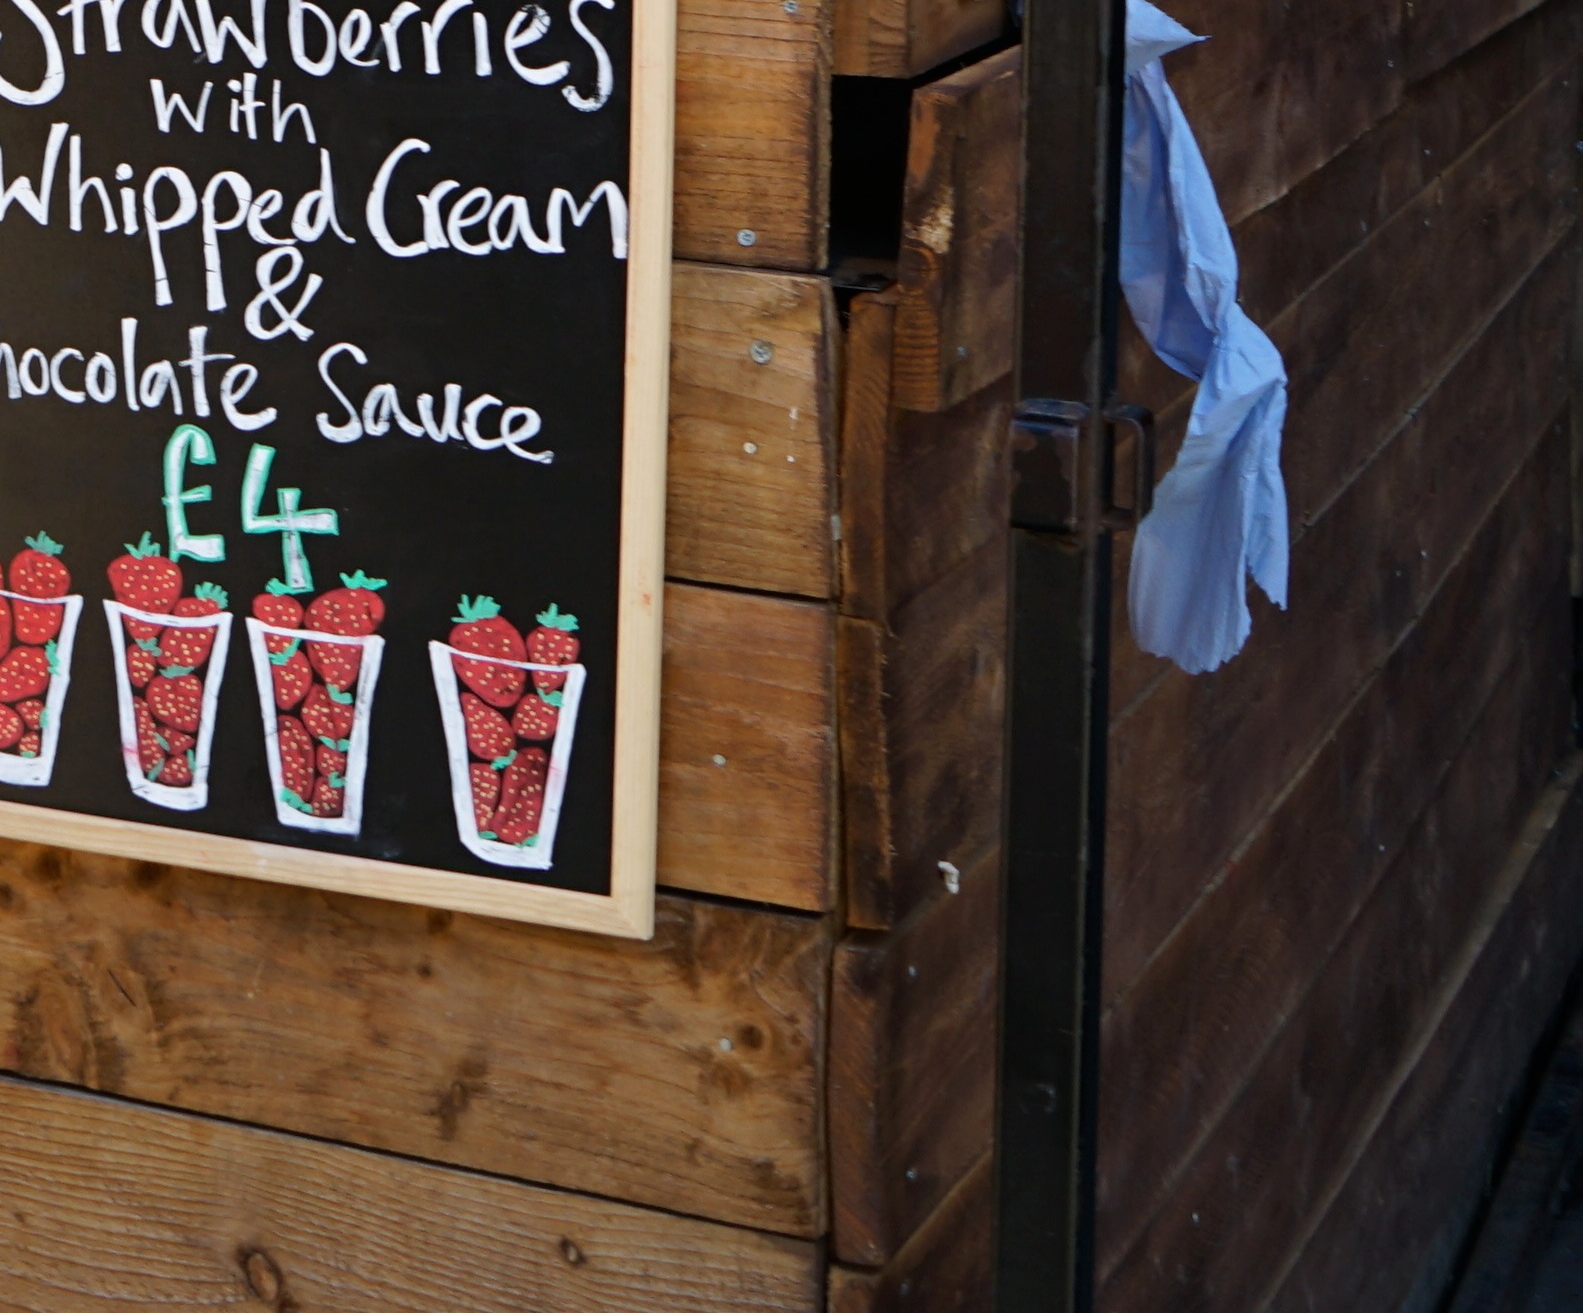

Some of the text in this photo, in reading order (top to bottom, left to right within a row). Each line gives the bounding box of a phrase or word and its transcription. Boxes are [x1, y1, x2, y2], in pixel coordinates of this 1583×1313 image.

[150, 74, 318, 147] with
[365, 139, 628, 259] Cream
[243, 246, 323, 343] &
[318, 343, 553, 463] Sauce
[161, 424, 339, 594] £4
